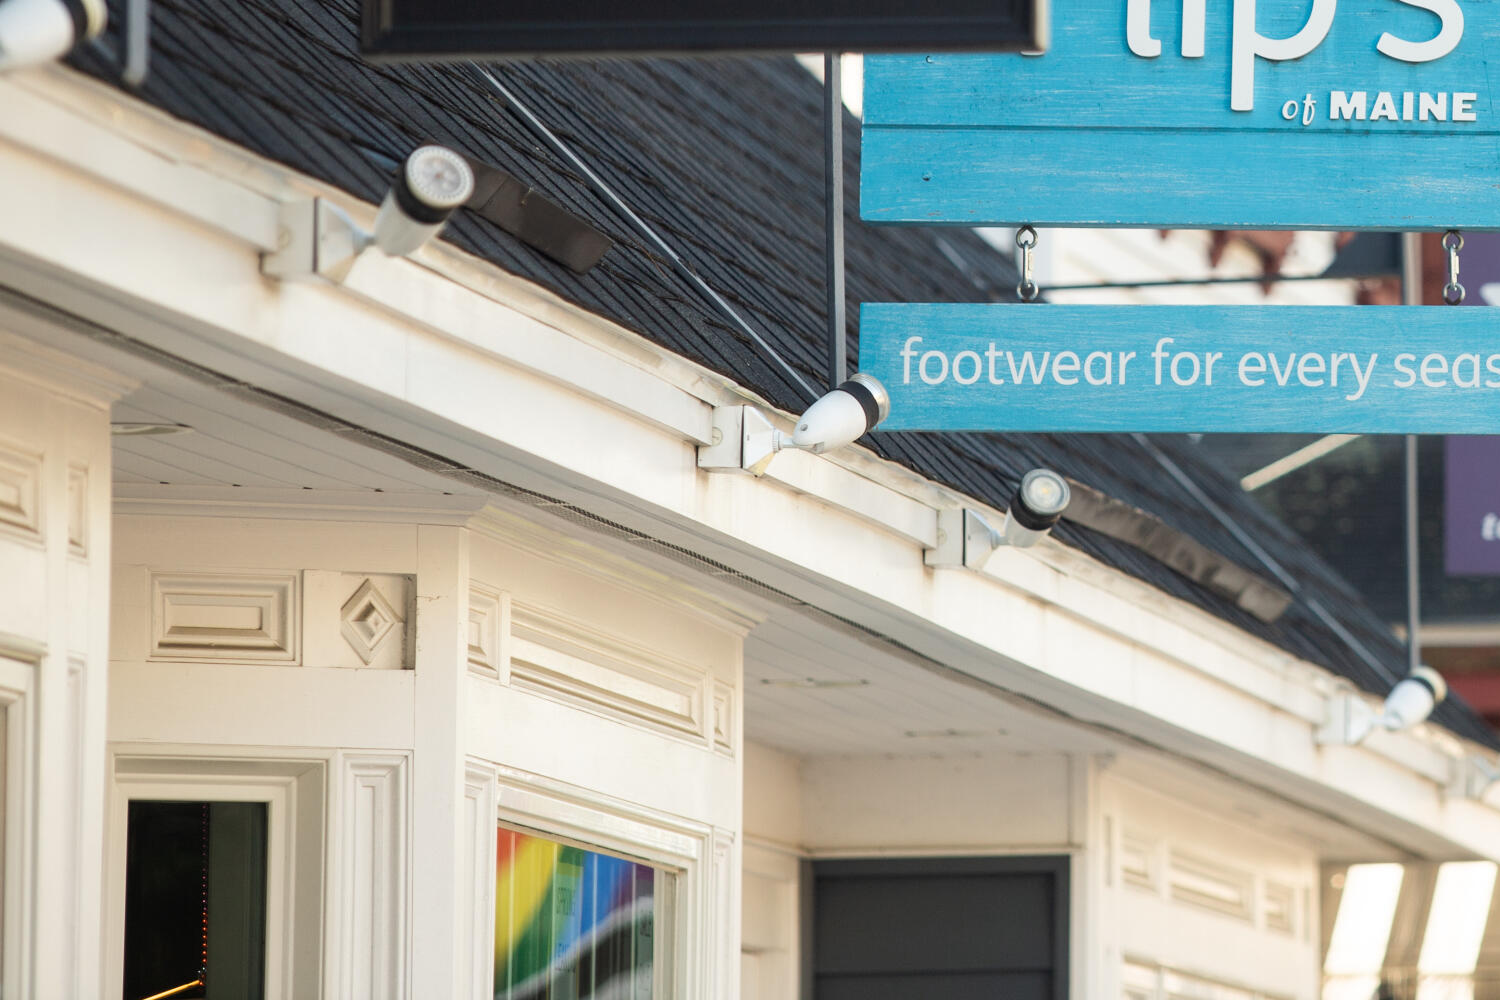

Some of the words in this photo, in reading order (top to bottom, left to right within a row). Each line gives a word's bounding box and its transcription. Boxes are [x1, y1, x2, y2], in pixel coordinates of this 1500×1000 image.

[1282, 97, 1317, 126] of
[1329, 91, 1478, 122] MAINE
[900, 335, 1138, 386] footwear
[1151, 337, 1225, 387] for
[1238, 350, 1379, 400] every
